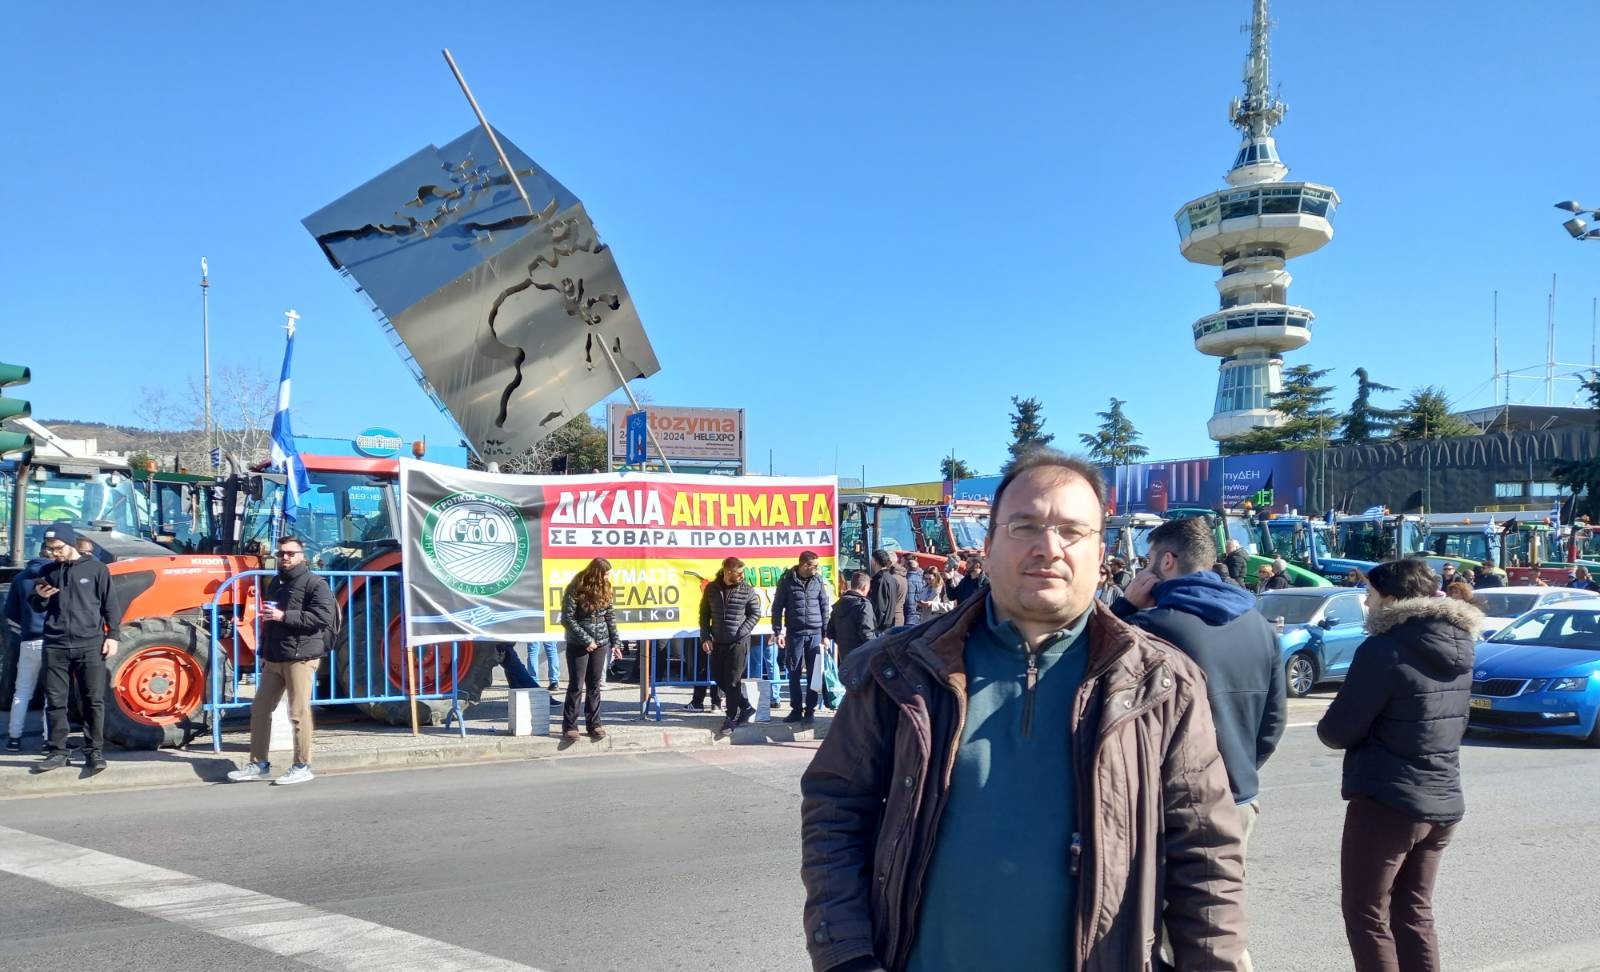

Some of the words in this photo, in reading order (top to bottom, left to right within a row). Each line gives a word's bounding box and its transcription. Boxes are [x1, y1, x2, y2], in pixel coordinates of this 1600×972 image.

[663, 432, 685, 441] 2024
[694, 432, 736, 442] HELEXPO
[550, 490, 666, 526] ΔΙΚΑΙΑ
[671, 491, 833, 527] ΑΙΤΗΜΑΤΑ
[550, 530, 577, 545] ΣΕ
[591, 530, 679, 547] ΣΟΒΑΡΑ
[690, 531, 832, 547] ΠΡΟΒΛΗΜΑΤΑ
[549, 585, 680, 607] ΠΕΛΑΙΟ
